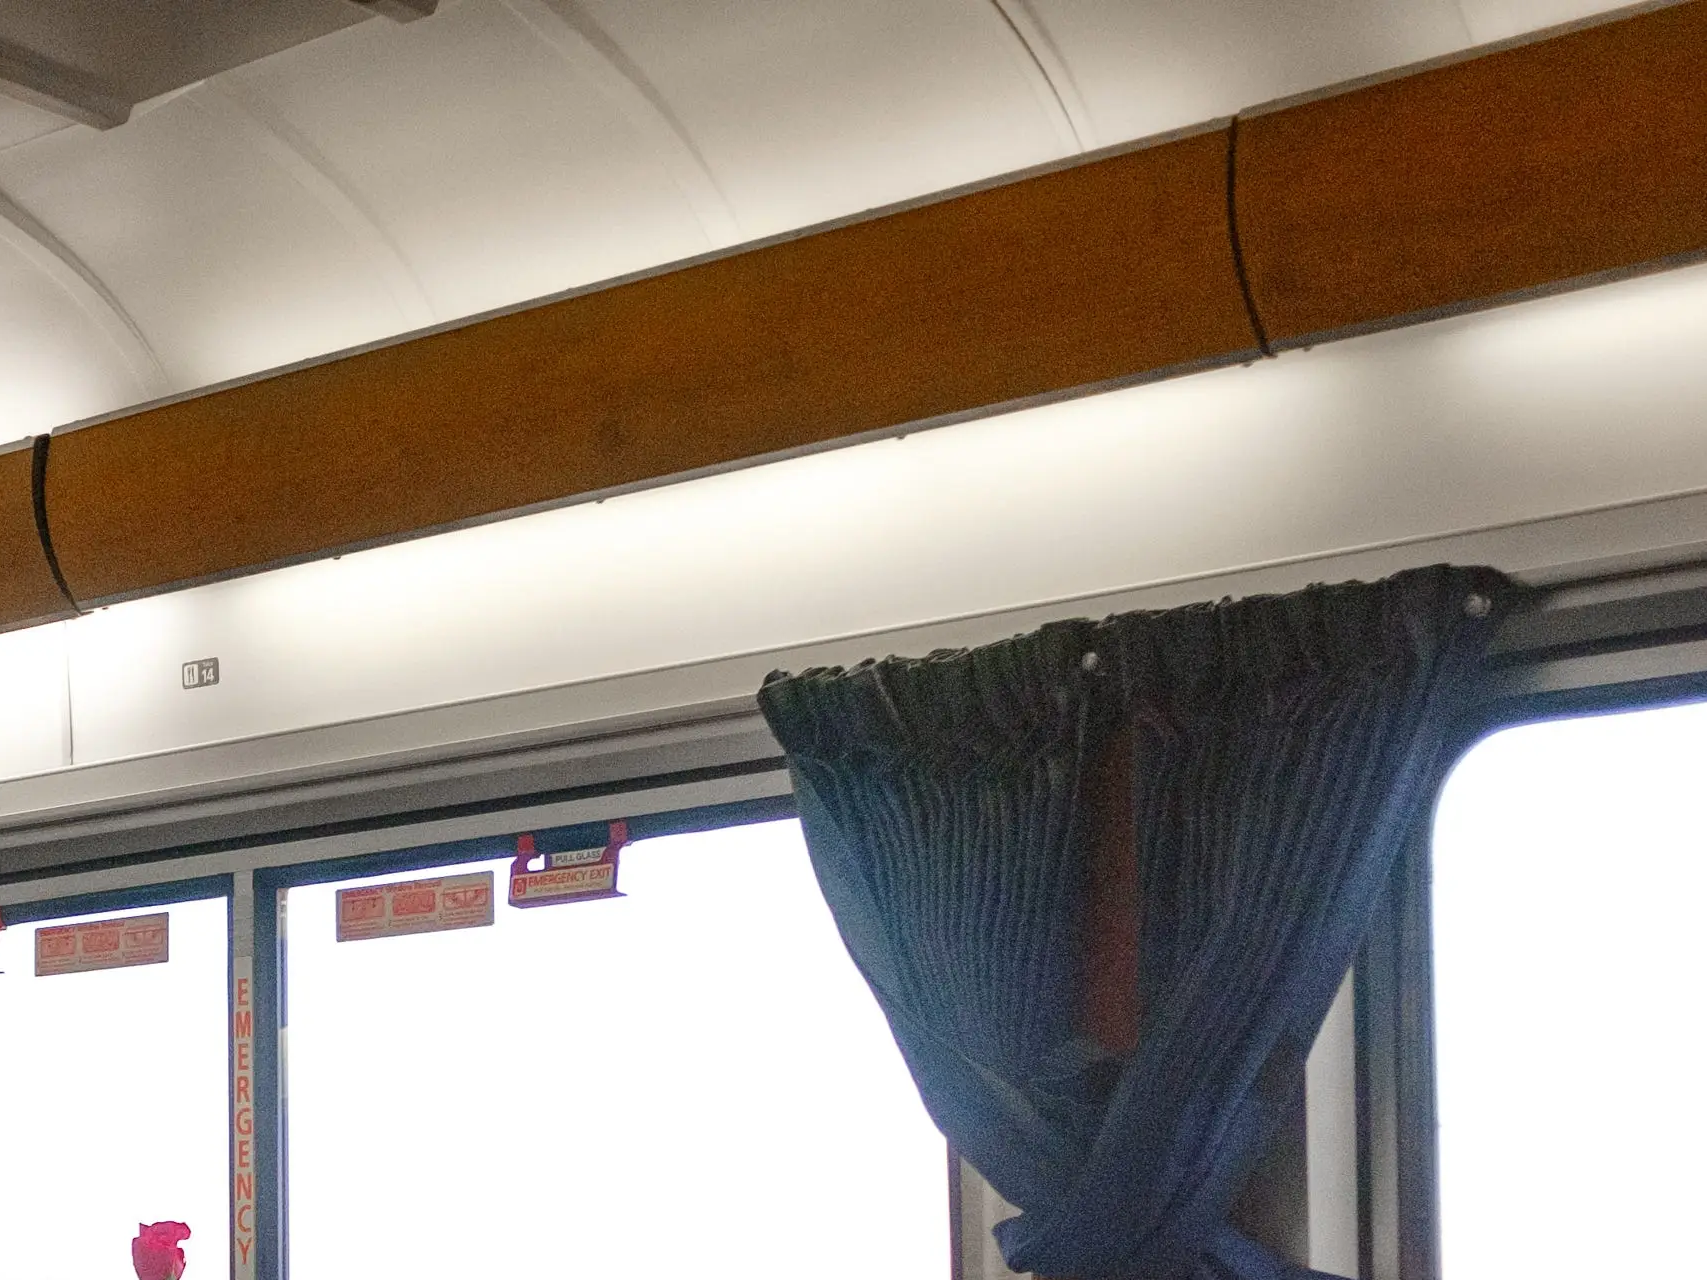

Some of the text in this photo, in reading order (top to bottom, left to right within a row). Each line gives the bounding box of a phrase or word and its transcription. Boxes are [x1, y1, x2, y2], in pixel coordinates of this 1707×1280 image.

[201, 667, 214, 683] 14
[555, 849, 601, 863] PULL GLASS
[528, 869, 587, 888] EMERGENCY
[589, 866, 611, 880] EXIT
[234, 977, 254, 1266] EMERGENCY
